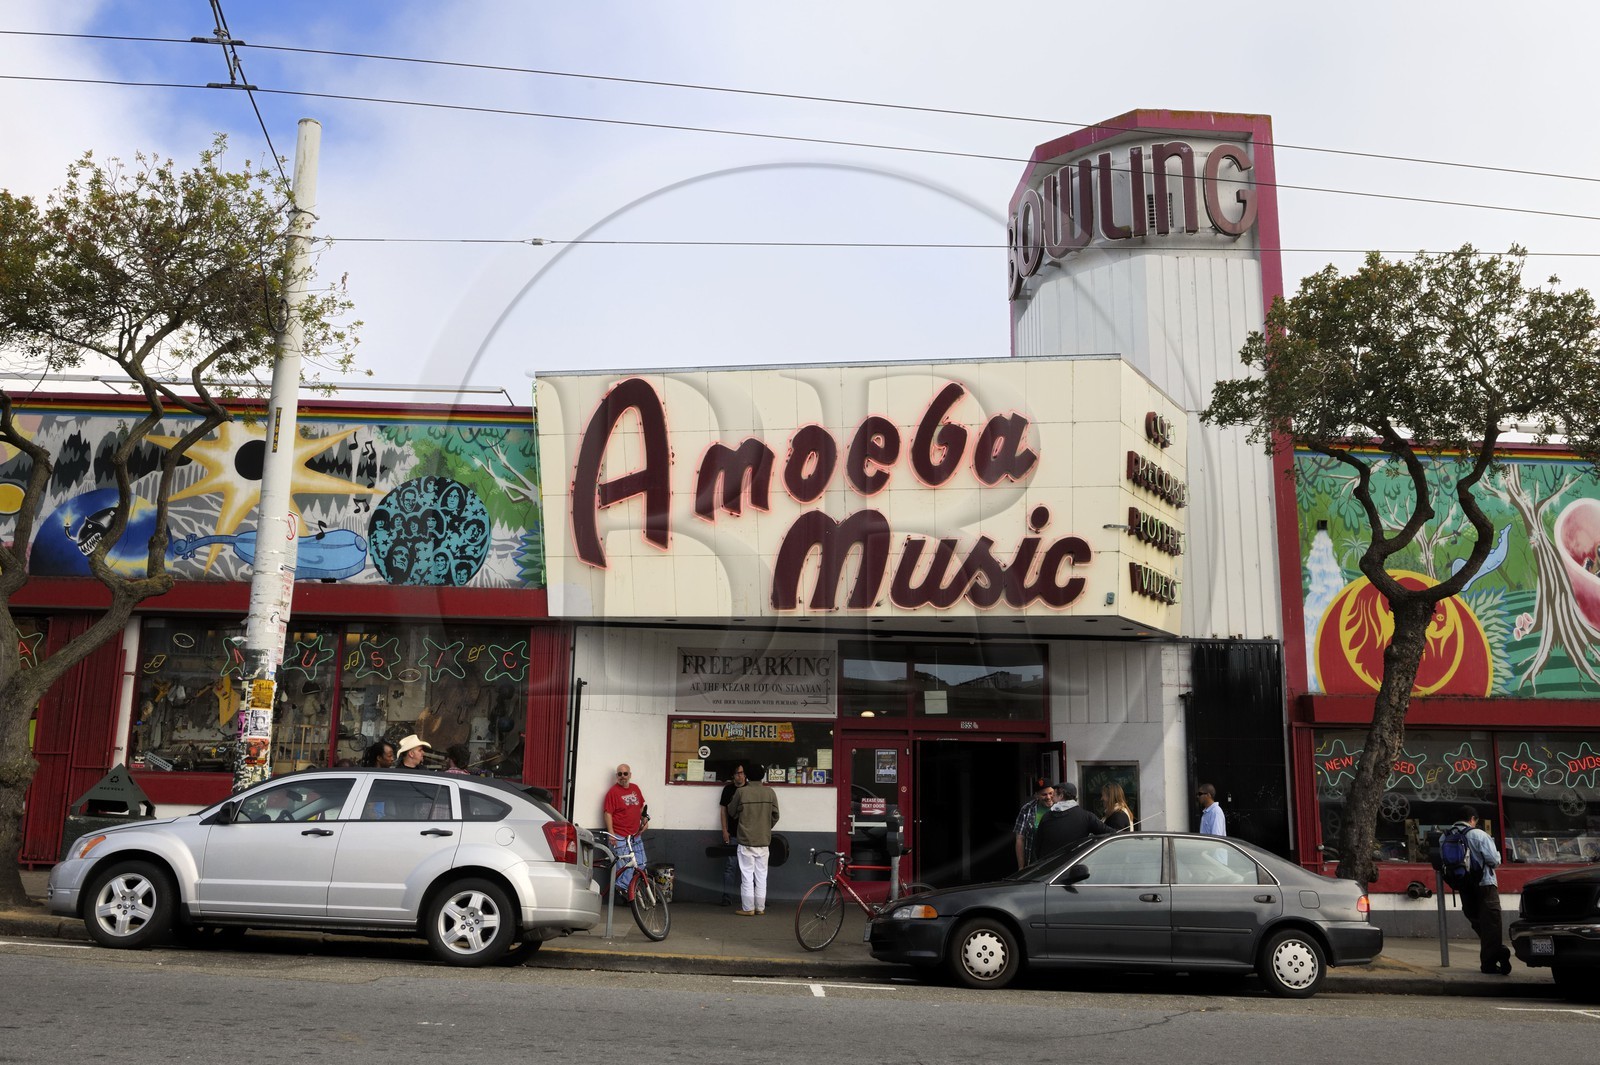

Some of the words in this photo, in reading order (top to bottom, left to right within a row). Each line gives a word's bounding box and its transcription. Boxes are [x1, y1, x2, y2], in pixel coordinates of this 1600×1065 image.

[571, 376, 1039, 569] Amoeba
[772, 504, 1093, 610] Music
[681, 655, 733, 675] FREE
[742, 657, 831, 677] PARKING
[690, 682, 701, 691] AT
[703, 683, 720, 691] THE
[722, 683, 750, 692] KEZAR
[753, 683, 768, 692] LOT
[772, 683, 783, 692] ON
[785, 683, 822, 693] STANYAN
[703, 724, 726, 737] BUY
[745, 725, 777, 738] HERE!
[1325, 756, 1353, 771] NEW
[1393, 760, 1416, 774] SED
